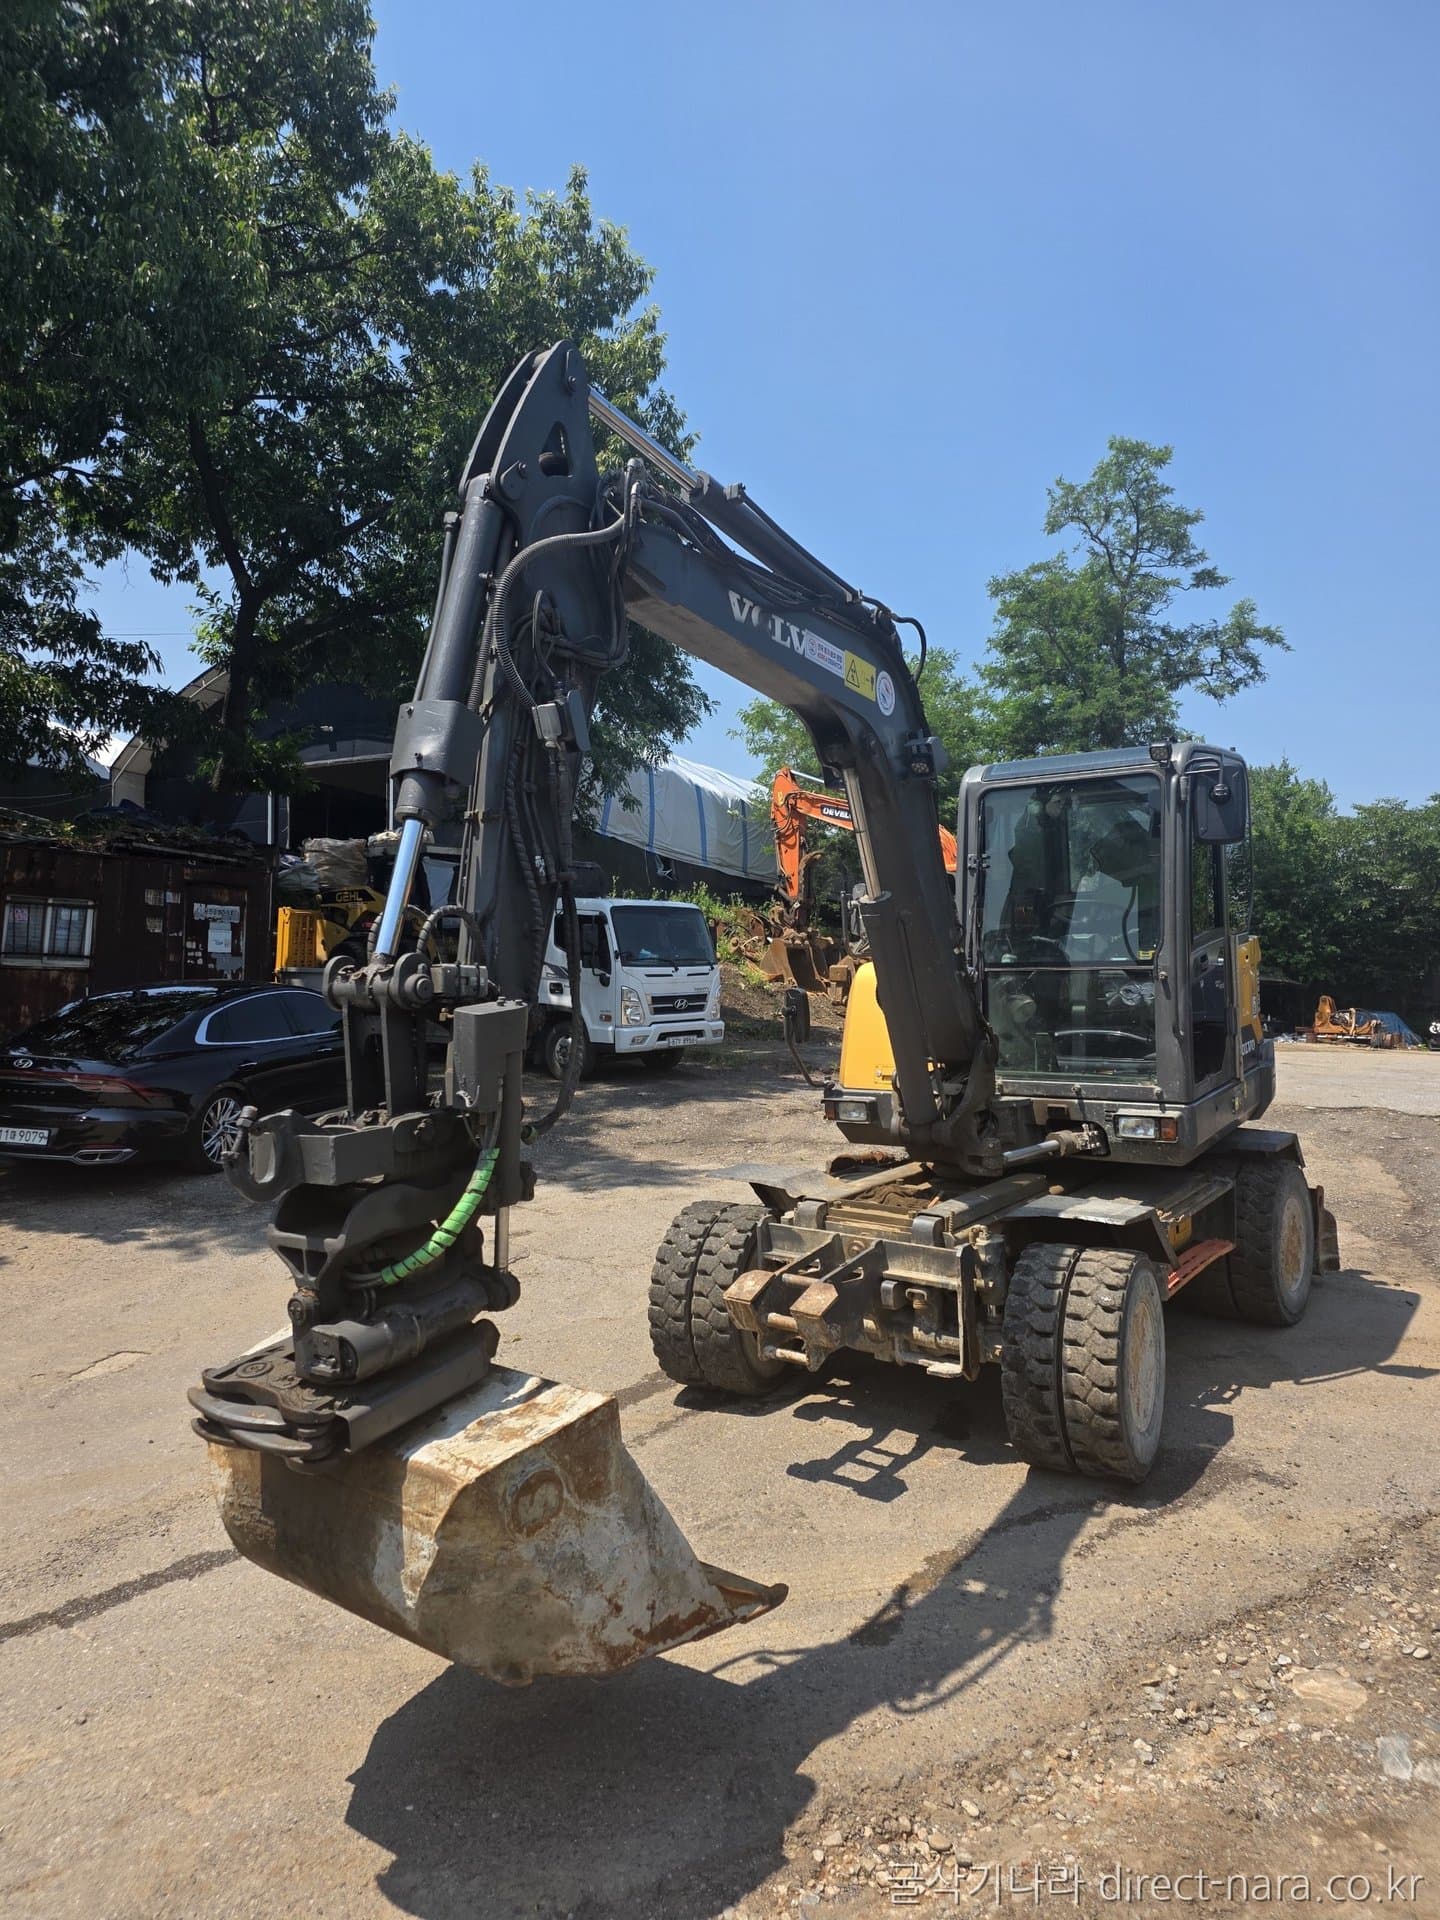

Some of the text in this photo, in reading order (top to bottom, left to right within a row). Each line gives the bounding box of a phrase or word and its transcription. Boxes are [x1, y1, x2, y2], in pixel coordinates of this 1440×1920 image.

[823, 807, 851, 819] DEVEL
[336, 890, 363, 902] GEHL
[19, 1130, 45, 1143] 9079
